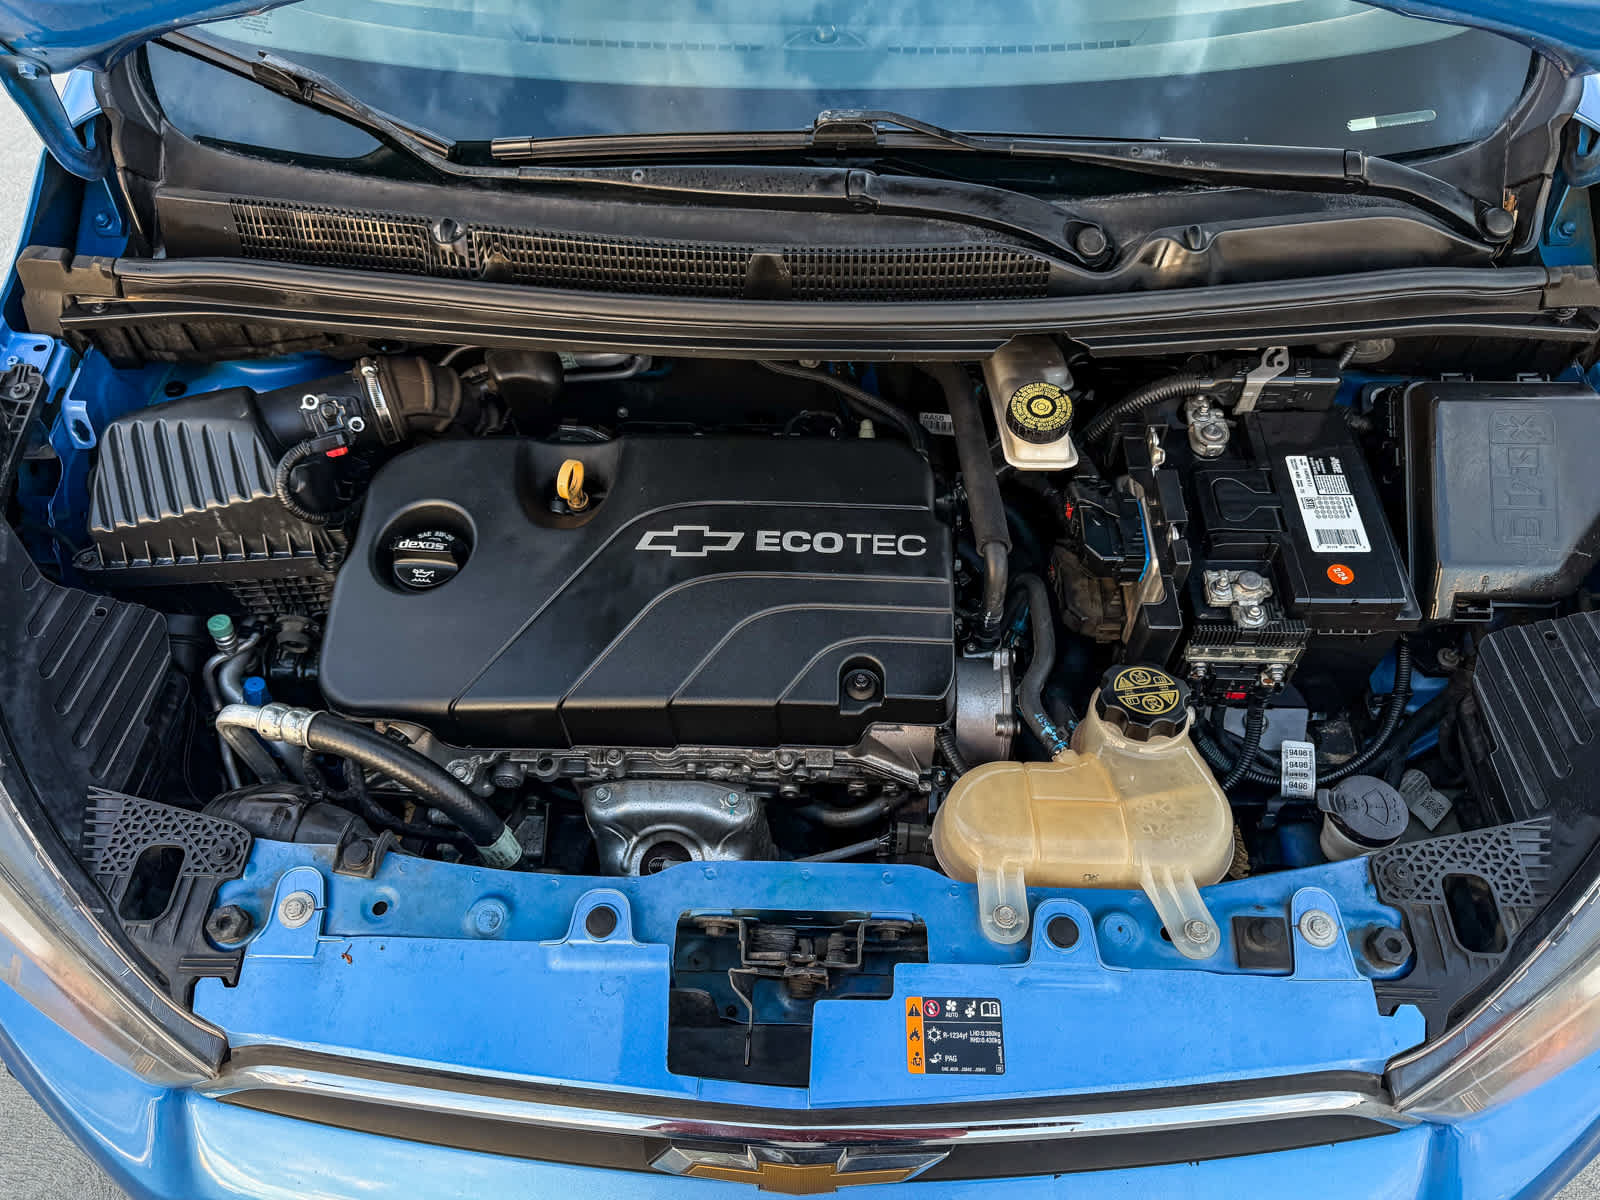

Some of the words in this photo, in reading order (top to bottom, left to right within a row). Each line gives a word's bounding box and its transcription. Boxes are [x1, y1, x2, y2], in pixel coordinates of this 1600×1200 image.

[398, 539, 445, 550] dexos
[756, 530, 927, 556] ECOTEC
[945, 1055, 958, 1063] PAG
